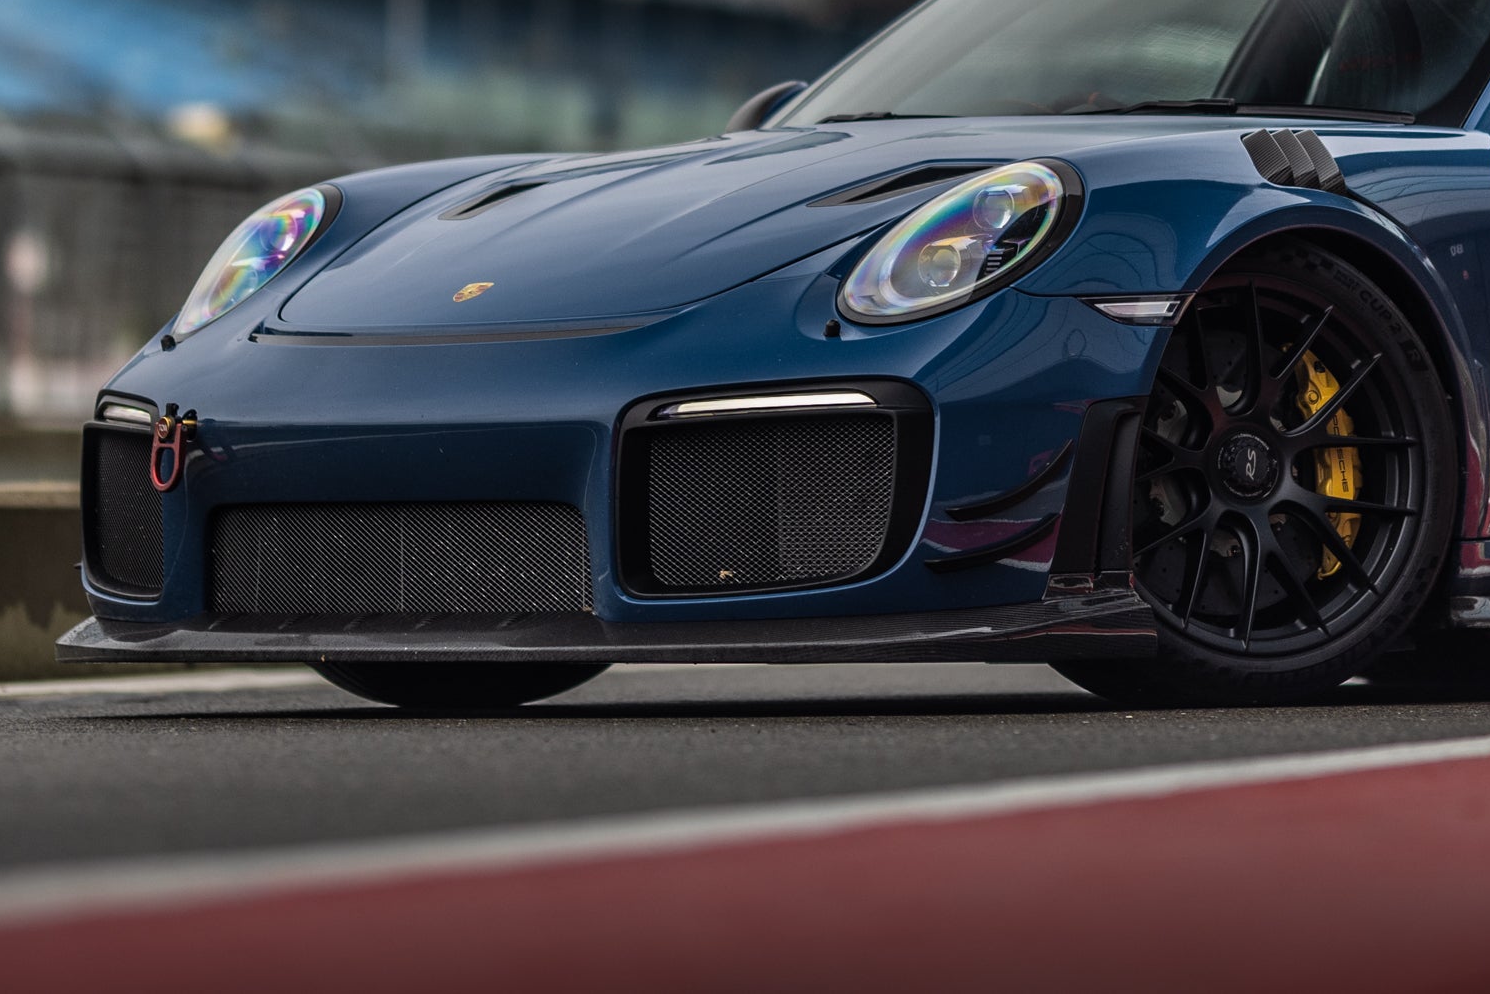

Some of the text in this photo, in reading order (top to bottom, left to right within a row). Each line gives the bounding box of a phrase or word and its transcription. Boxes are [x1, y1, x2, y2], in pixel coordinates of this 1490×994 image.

[1359, 290, 1392, 323] CUP
[1389, 322, 1402, 336] 2
[1245, 448, 1257, 482] RS
[1332, 415, 1349, 493] POSCHE
